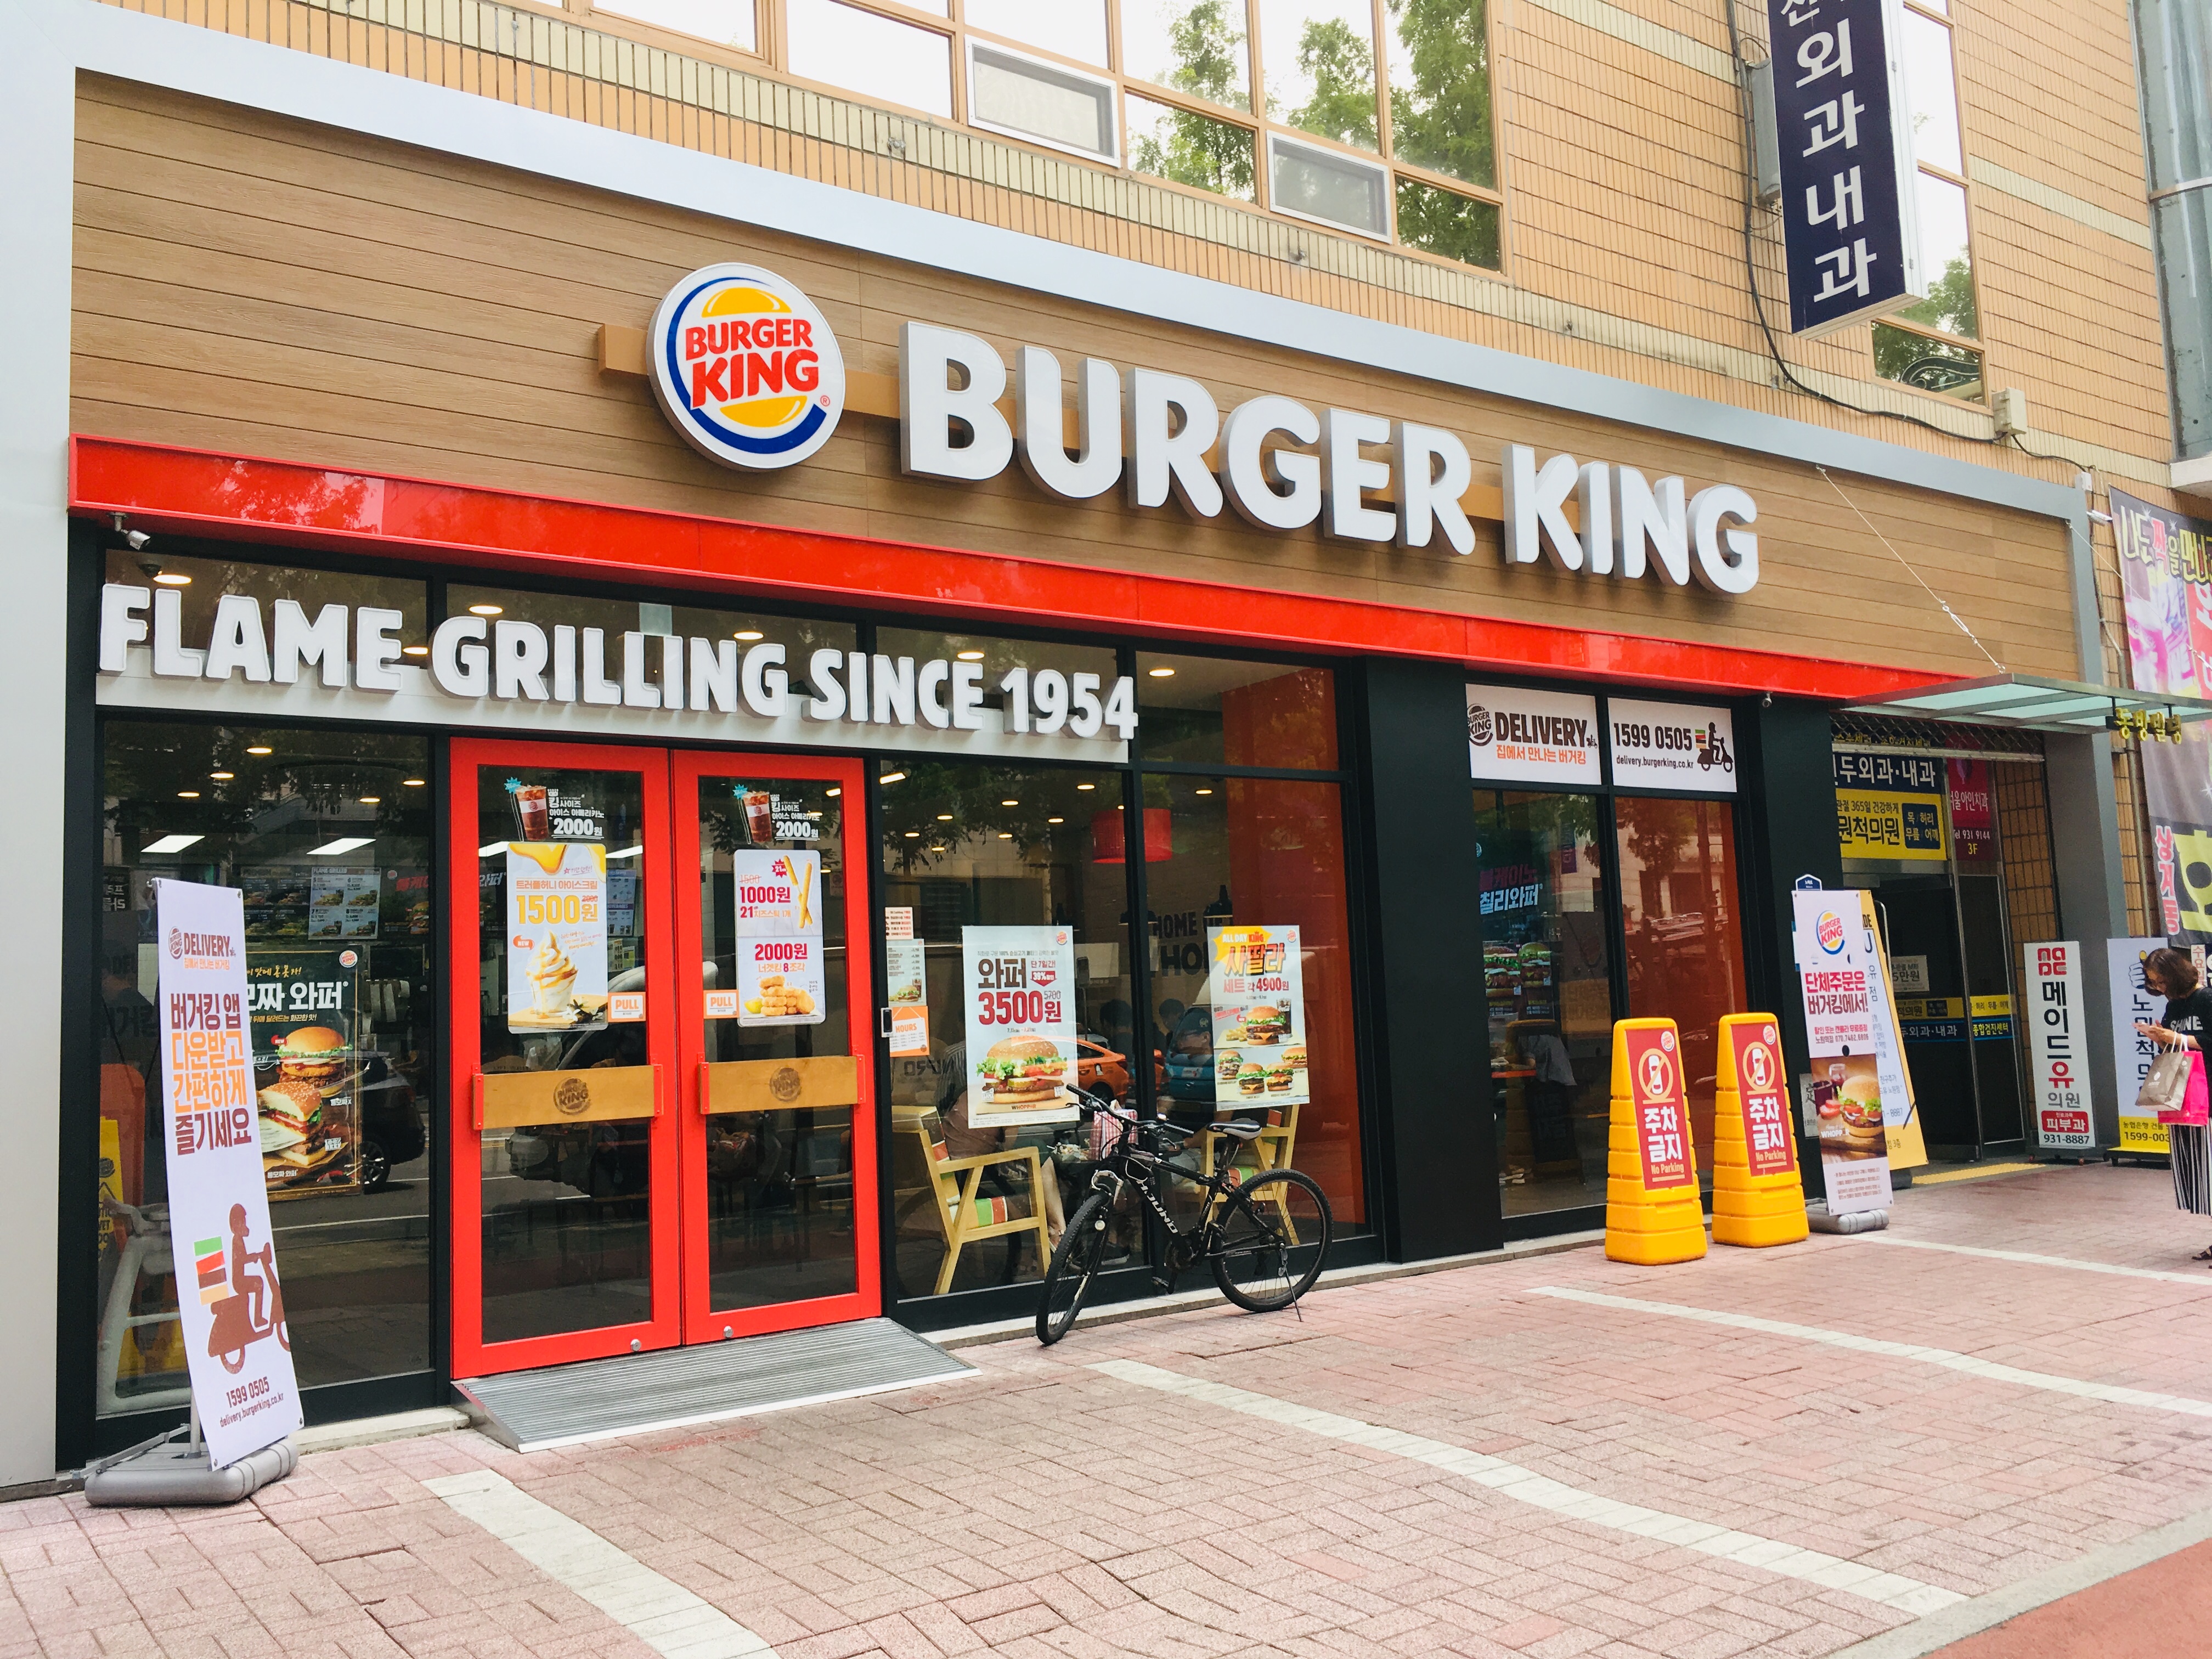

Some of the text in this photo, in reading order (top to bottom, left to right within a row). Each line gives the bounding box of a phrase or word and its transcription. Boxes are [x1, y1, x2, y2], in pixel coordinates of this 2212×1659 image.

[686, 318, 814, 360] BURGER
[691, 349, 819, 408] KING
[899, 321, 1760, 595] BURGER KING
[99, 583, 1138, 740] FLAME GRILLING SINCE 1954
[1494, 712, 1588, 748] DELIVERY
[1613, 723, 1693, 751] 1599 0505
[1496, 744, 1587, 765] 집에서 만나는 버거킹
[1616, 755, 1694, 769] delivery.burgerking.co.kr
[549, 809, 570, 817] 아이스
[1851, 801, 1871, 812] 365일
[1872, 802, 1900, 814] 건강하게
[554, 818, 603, 837] 2000원
[1920, 812, 1934, 826] 허리
[776, 821, 819, 838] 2000원
[1905, 827, 1920, 842] 무릎
[1962, 830, 1973, 840] 931
[1975, 830, 1991, 840] 9144
[1967, 843, 1978, 855] 3F
[558, 880, 599, 890] 아이스크림
[740, 886, 791, 904] 1000원
[1480, 884, 1539, 915] 칠리와퍼
[1819, 917, 1841, 935] BURGER
[184, 933, 230, 957] DELIVERY
[1222, 934, 1234, 943] ALL
[1235, 934, 1248, 943] DAY
[1820, 925, 1843, 947] KING
[754, 943, 808, 961] 2000원
[758, 963, 782, 973] 너겟킹
[783, 963, 789, 973] 8
[978, 958, 1027, 989] 와퍼
[1032, 972, 1046, 980] 39%
[1223, 978, 1245, 994] 세트
[1256, 977, 1289, 992] 4900원
[1805, 971, 1866, 994] 단체주문은
[289, 981, 342, 1011] 와퍼
[615, 999, 640, 1010] PULL
[710, 996, 733, 1007] PULL
[1807, 992, 1869, 1015] 버거킹에서!
[170, 993, 241, 1031] 버거킹 앱
[895, 1023, 917, 1033] HOURS
[1973, 1022, 2010, 1036] 종합검진센터
[2042, 981, 2075, 1089] 메이드유
[171, 1030, 245, 1071] 다운받고
[173, 1068, 248, 1114] 간편하게
[1750, 1096, 1780, 1122] 주차
[2048, 1092, 2081, 1109] 의원
[1644, 1105, 1678, 1132] 주차
[2046, 1118, 2086, 1132] 피부과
[2123, 1121, 2149, 1130] 농협은행
[175, 1107, 252, 1156] 즐기세요
[1752, 1122, 1785, 1151] 금지
[2044, 1133, 2090, 1144] 931-8887
[1647, 1132, 1683, 1163] 금지
[1756, 1150, 1786, 1163] No Parking
[1651, 1162, 1684, 1175] No Parking
[226, 1376, 270, 1408] 1599 0505
[219, 1391, 284, 1427] delivery.burgerking.co.kr
